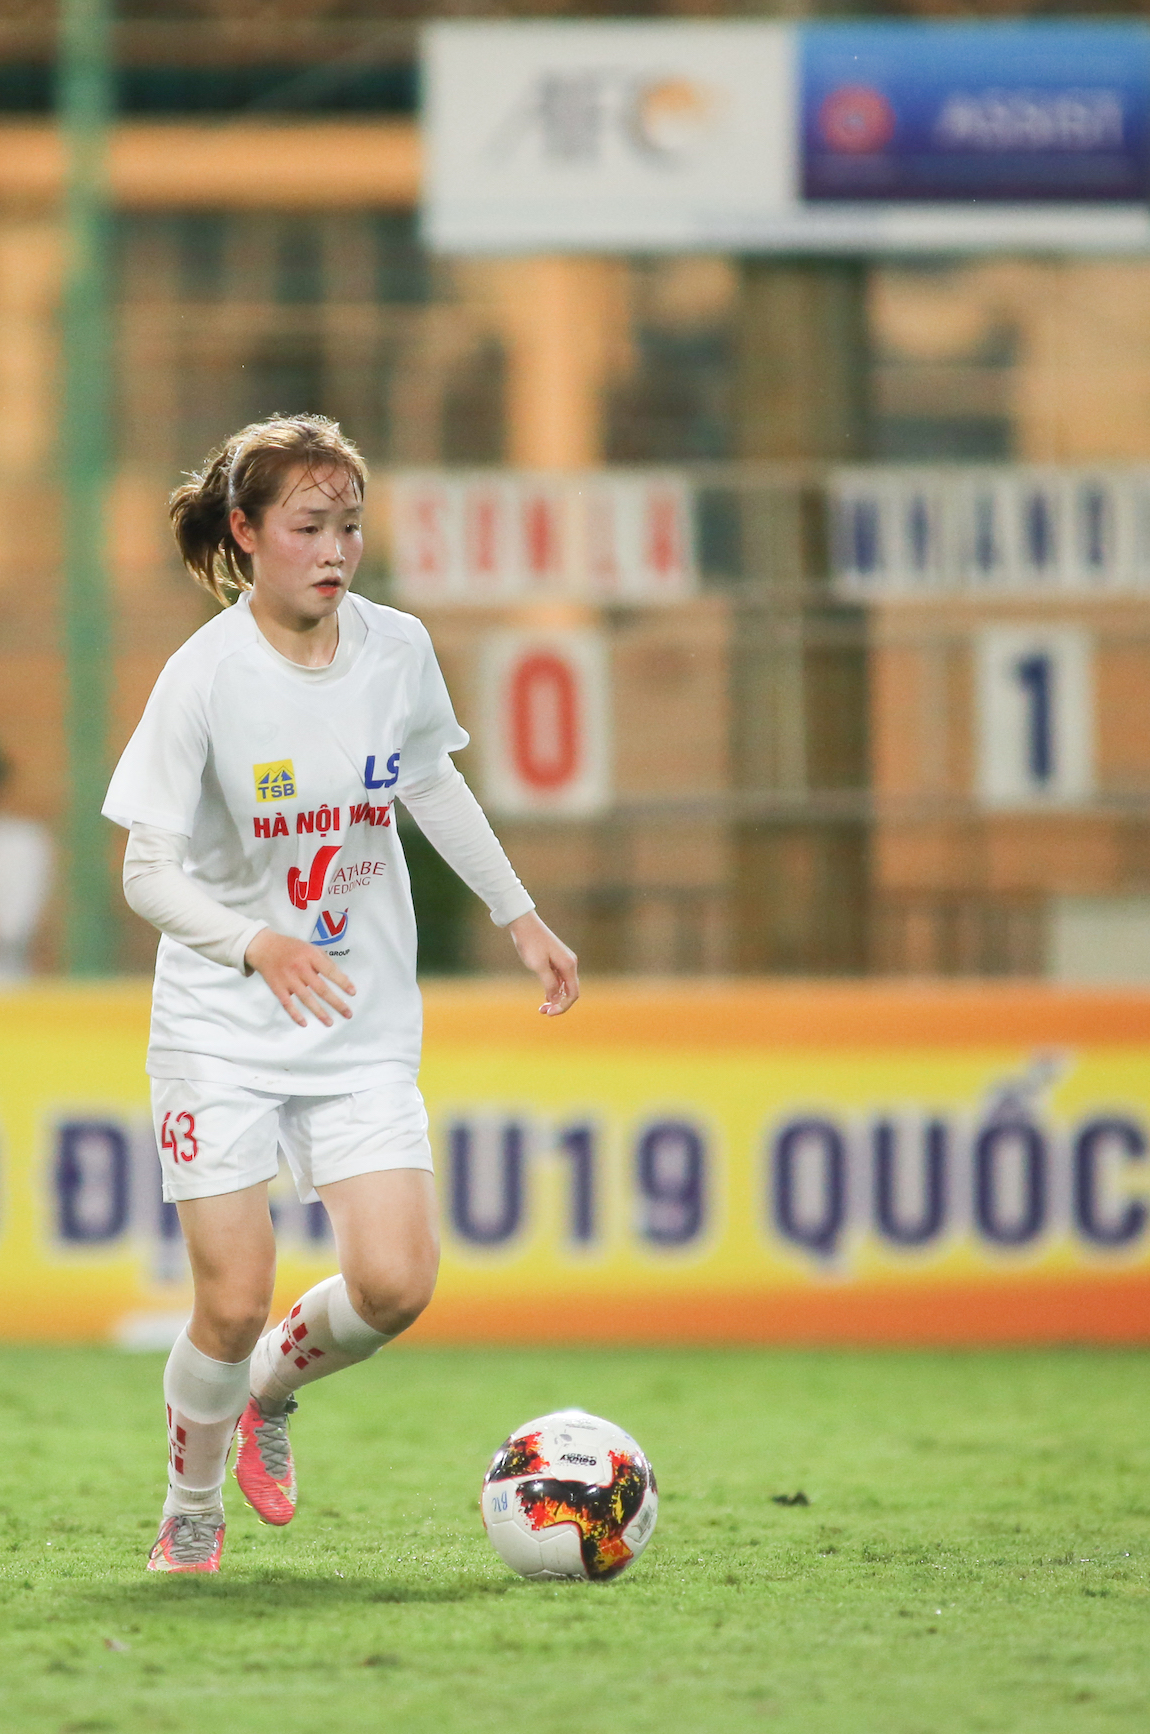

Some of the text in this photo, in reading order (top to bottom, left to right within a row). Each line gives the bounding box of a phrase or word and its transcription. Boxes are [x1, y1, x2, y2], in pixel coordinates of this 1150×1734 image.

[505, 650, 582, 792] 0
[1015, 652, 1055, 786] 1
[257, 782, 296, 800] TSB
[253, 812, 290, 839] HÀ
[296, 803, 341, 838] NỘI
[331, 860, 387, 883] ATABE
[328, 949, 351, 957] GROUP
[161, 1111, 199, 1164] 43
[446, 1118, 708, 1248] U19
[770, 1048, 1149, 1260] QUỐC
